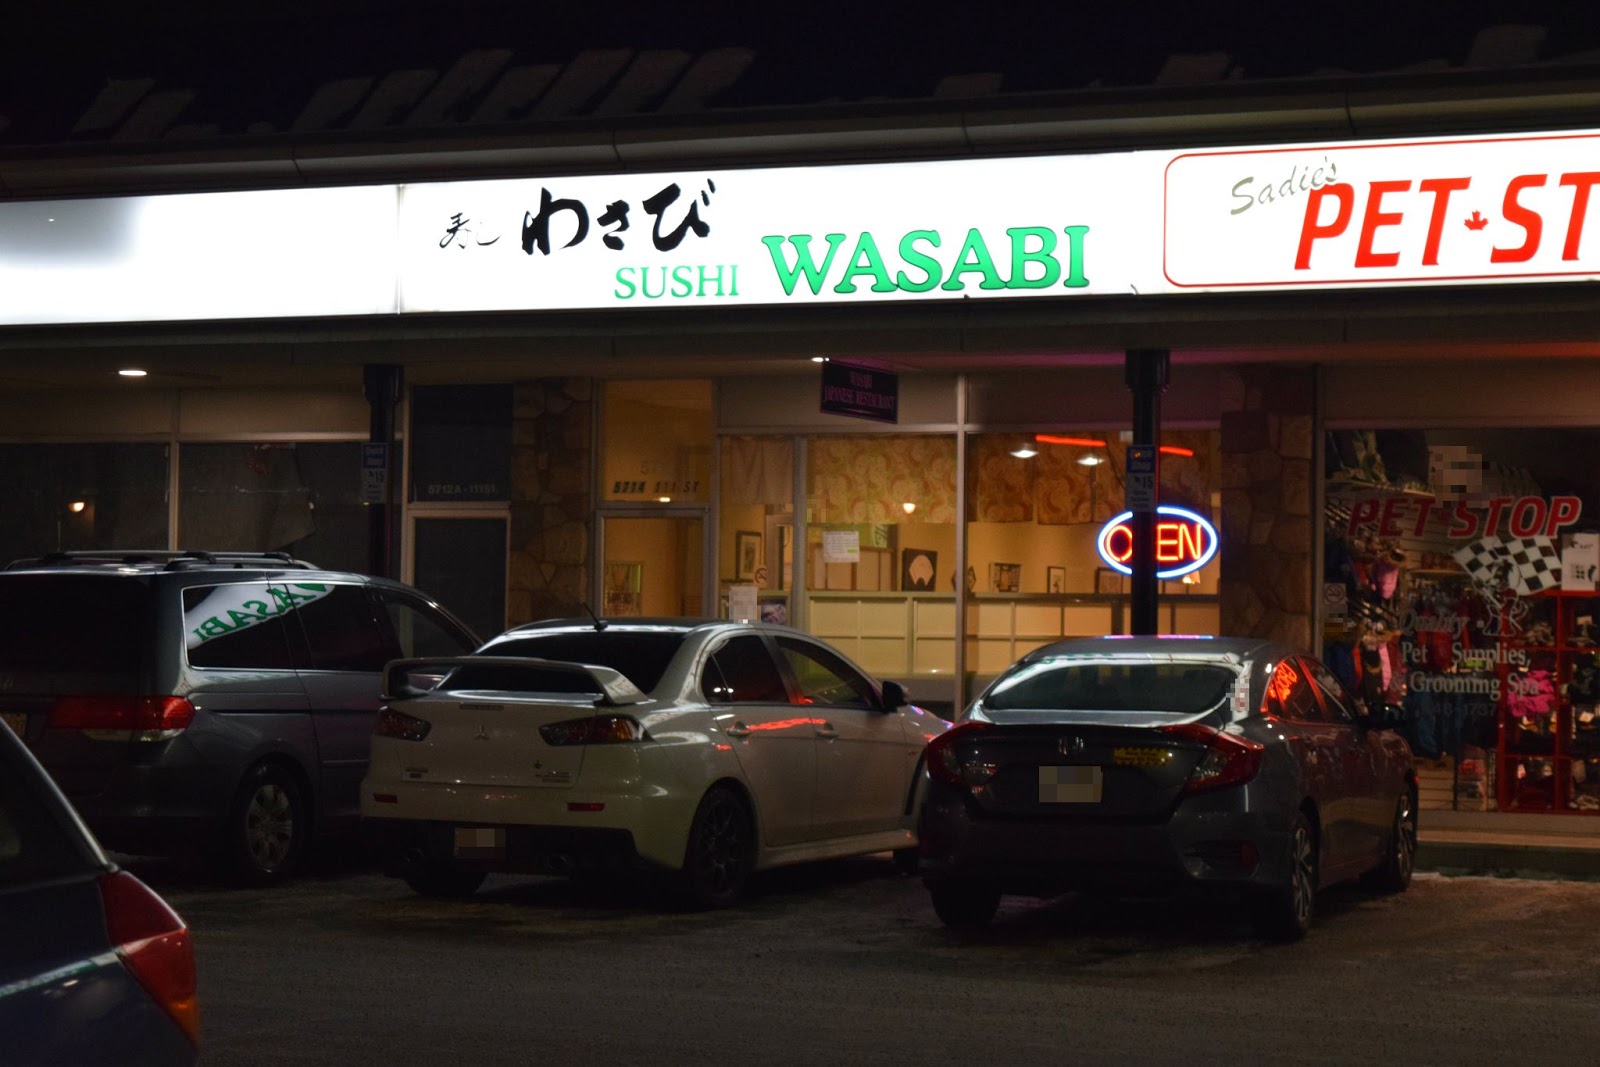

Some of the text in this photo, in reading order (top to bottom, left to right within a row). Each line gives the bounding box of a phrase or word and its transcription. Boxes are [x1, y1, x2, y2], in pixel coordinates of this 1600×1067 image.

[1230, 156, 1337, 215] Sadie's
[522, 178, 716, 256] わさび
[1294, 176, 1472, 271] PET
[761, 225, 1091, 296] WASABI
[614, 264, 739, 300] SUSHI
[1348, 495, 1583, 539] PET STOP
[1105, 523, 1202, 562] OEN
[1400, 609, 1470, 640] Quality
[1401, 641, 1429, 664] Pet
[1410, 670, 1502, 702] Grooming
[1507, 672, 1540, 697] Spa
